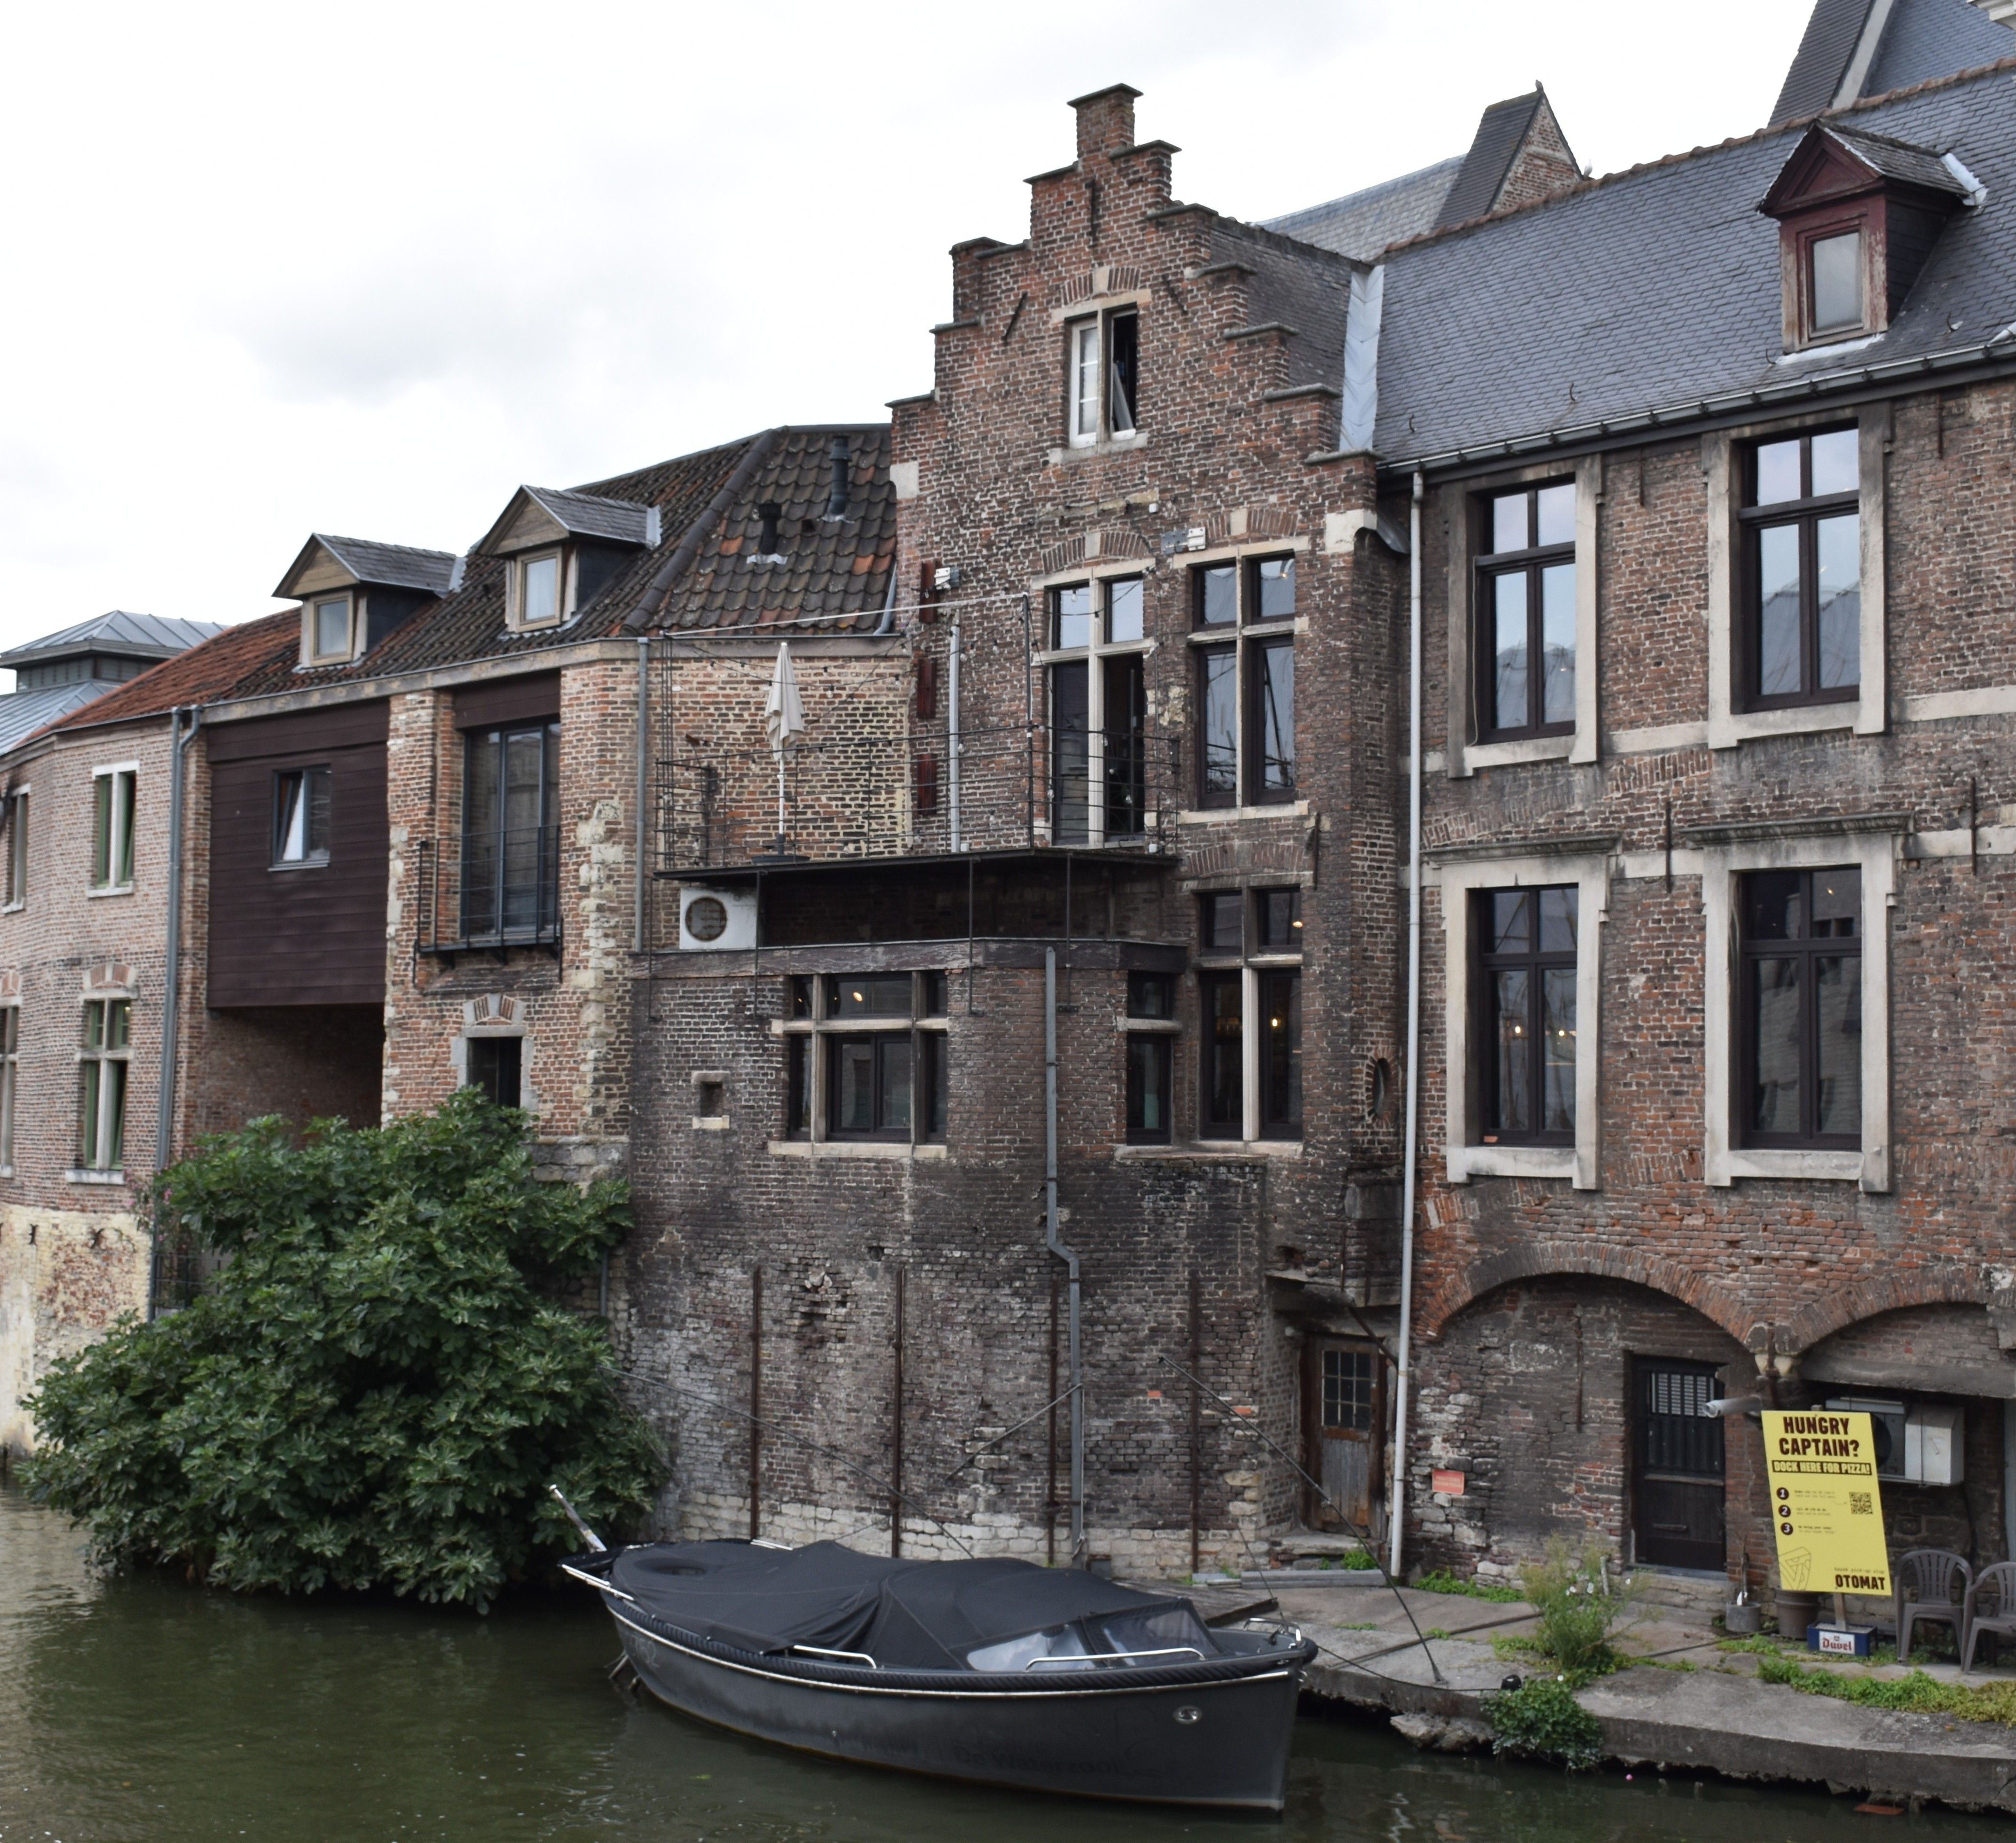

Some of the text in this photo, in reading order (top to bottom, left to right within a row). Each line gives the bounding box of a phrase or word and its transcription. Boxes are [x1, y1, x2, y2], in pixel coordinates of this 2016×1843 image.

[1783, 1416, 1849, 1435] HUNGRY
[1779, 1437, 1859, 1457] CAPTAIN?
[1773, 1461, 1870, 1474] DOCK HERE FOR PIZZA!
[1780, 1489, 1785, 1498] 1
[1781, 1506, 1788, 1515] 2
[1784, 1524, 1790, 1533] 3
[1835, 1574, 1885, 1590] OTOMAT
[1822, 1637, 1852, 1651] Duvel
